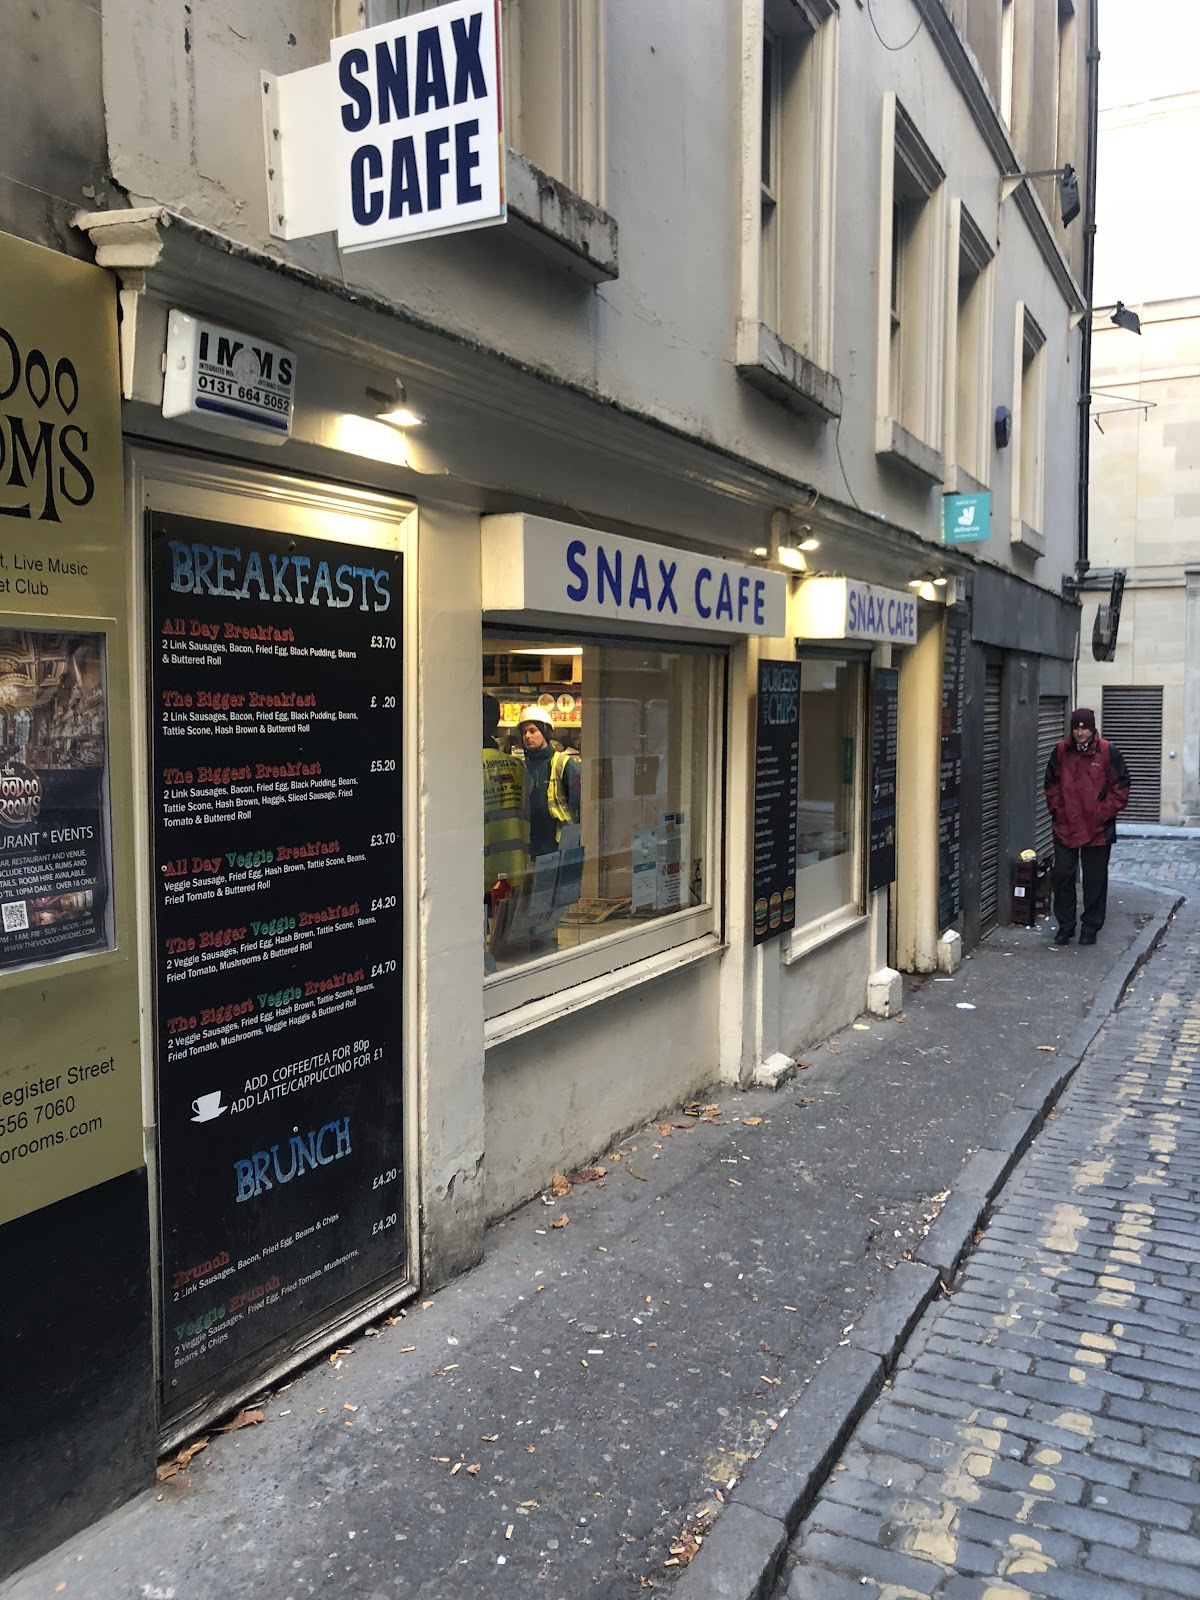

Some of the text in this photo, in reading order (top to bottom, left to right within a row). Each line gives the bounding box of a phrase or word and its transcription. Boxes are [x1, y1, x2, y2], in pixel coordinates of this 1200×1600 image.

[338, 12, 488, 132] SNAX
[350, 118, 482, 226] CAFE
[198, 376, 233, 395] 0131
[238, 386, 261, 404] 664
[263, 394, 290, 412] 5052
[0, 414, 94, 523] MS
[14, 554, 44, 572] Live
[48, 558, 89, 576] Music
[168, 540, 391, 612] BREAKFASTS
[15, 578, 49, 596] Club
[566, 540, 765, 625] SNAX CAFE
[849, 591, 914, 636] SNAX CAFE
[162, 619, 294, 642] All Day Breakfast
[170, 640, 187, 649] Link
[189, 641, 227, 653] Sausages,
[229, 643, 254, 654] Bacon,
[256, 644, 273, 654] Fried
[290, 646, 308, 656] Black
[310, 648, 337, 659] Pudding,
[338, 649, 356, 658] Beans
[370, 636, 396, 650] £3.70
[171, 654, 221, 665] Buttered Roll
[163, 691, 316, 710] The Bigger Breakfast
[171, 711, 358, 722] Link Sausages, Bacon, Fried Black Beans,
[162, 724, 310, 735] Tattie Scone, Hash Brown Buttered Roll
[163, 762, 321, 784] The Biggest Breakfast
[370, 759, 396, 773] £5.20
[163, 789, 353, 813] Tattie Scone, Hash Brown, Sliced Sausage, Fried
[171, 780, 309, 798] Link Sausages, Bacon, Fried Black
[163, 810, 251, 827] Tomato Buttered Roll
[51, 826, 93, 843] EVENTS
[370, 832, 396, 847] £3.70
[52, 852, 65, 860] AND
[55, 861, 72, 869] RUMS
[73, 859, 87, 867] AND
[164, 840, 340, 876] All Day Veggie Breakfast
[56, 881, 72, 889] OVER
[164, 871, 246, 892] Veggie Sausage, Fried
[165, 880, 270, 905] Fried Tomato Buttered Roll
[370, 896, 396, 912] £4.20
[166, 903, 360, 954] The Bigger Veggie Breakfast
[167, 941, 312, 983] Fried Tomato, Mushrooms Buttered Roll
[174, 941, 258, 967] Veggie Sausages, Fried
[370, 960, 396, 978] £4.70
[167, 969, 364, 1034] The Biggest Veggie Breakfast
[168, 999, 356, 1062] Fried Tomato, Mushrooms, Veggie Haggis Buttered Roll
[175, 1015, 258, 1046] Veggie Sausages, Fried
[244, 1040, 370, 1092] ADD COFFEE/TEA FOR 80p
[0, 1056, 116, 1107] egister Street
[230, 1047, 382, 1114] ADD LATTE/CAPPUCCINO FOR £1
[34, 1096, 75, 1124] 7060
[0, 1117, 102, 1164] orooms.com
[233, 1116, 353, 1203] BRUNCH
[372, 1168, 397, 1190] £4.20
[262, 1242, 279, 1257] Fried
[295, 1226, 315, 1240] Beans
[322, 1214, 339, 1226] Chips
[371, 1213, 397, 1236] £4.20
[172, 1251, 230, 1289] Brunch
